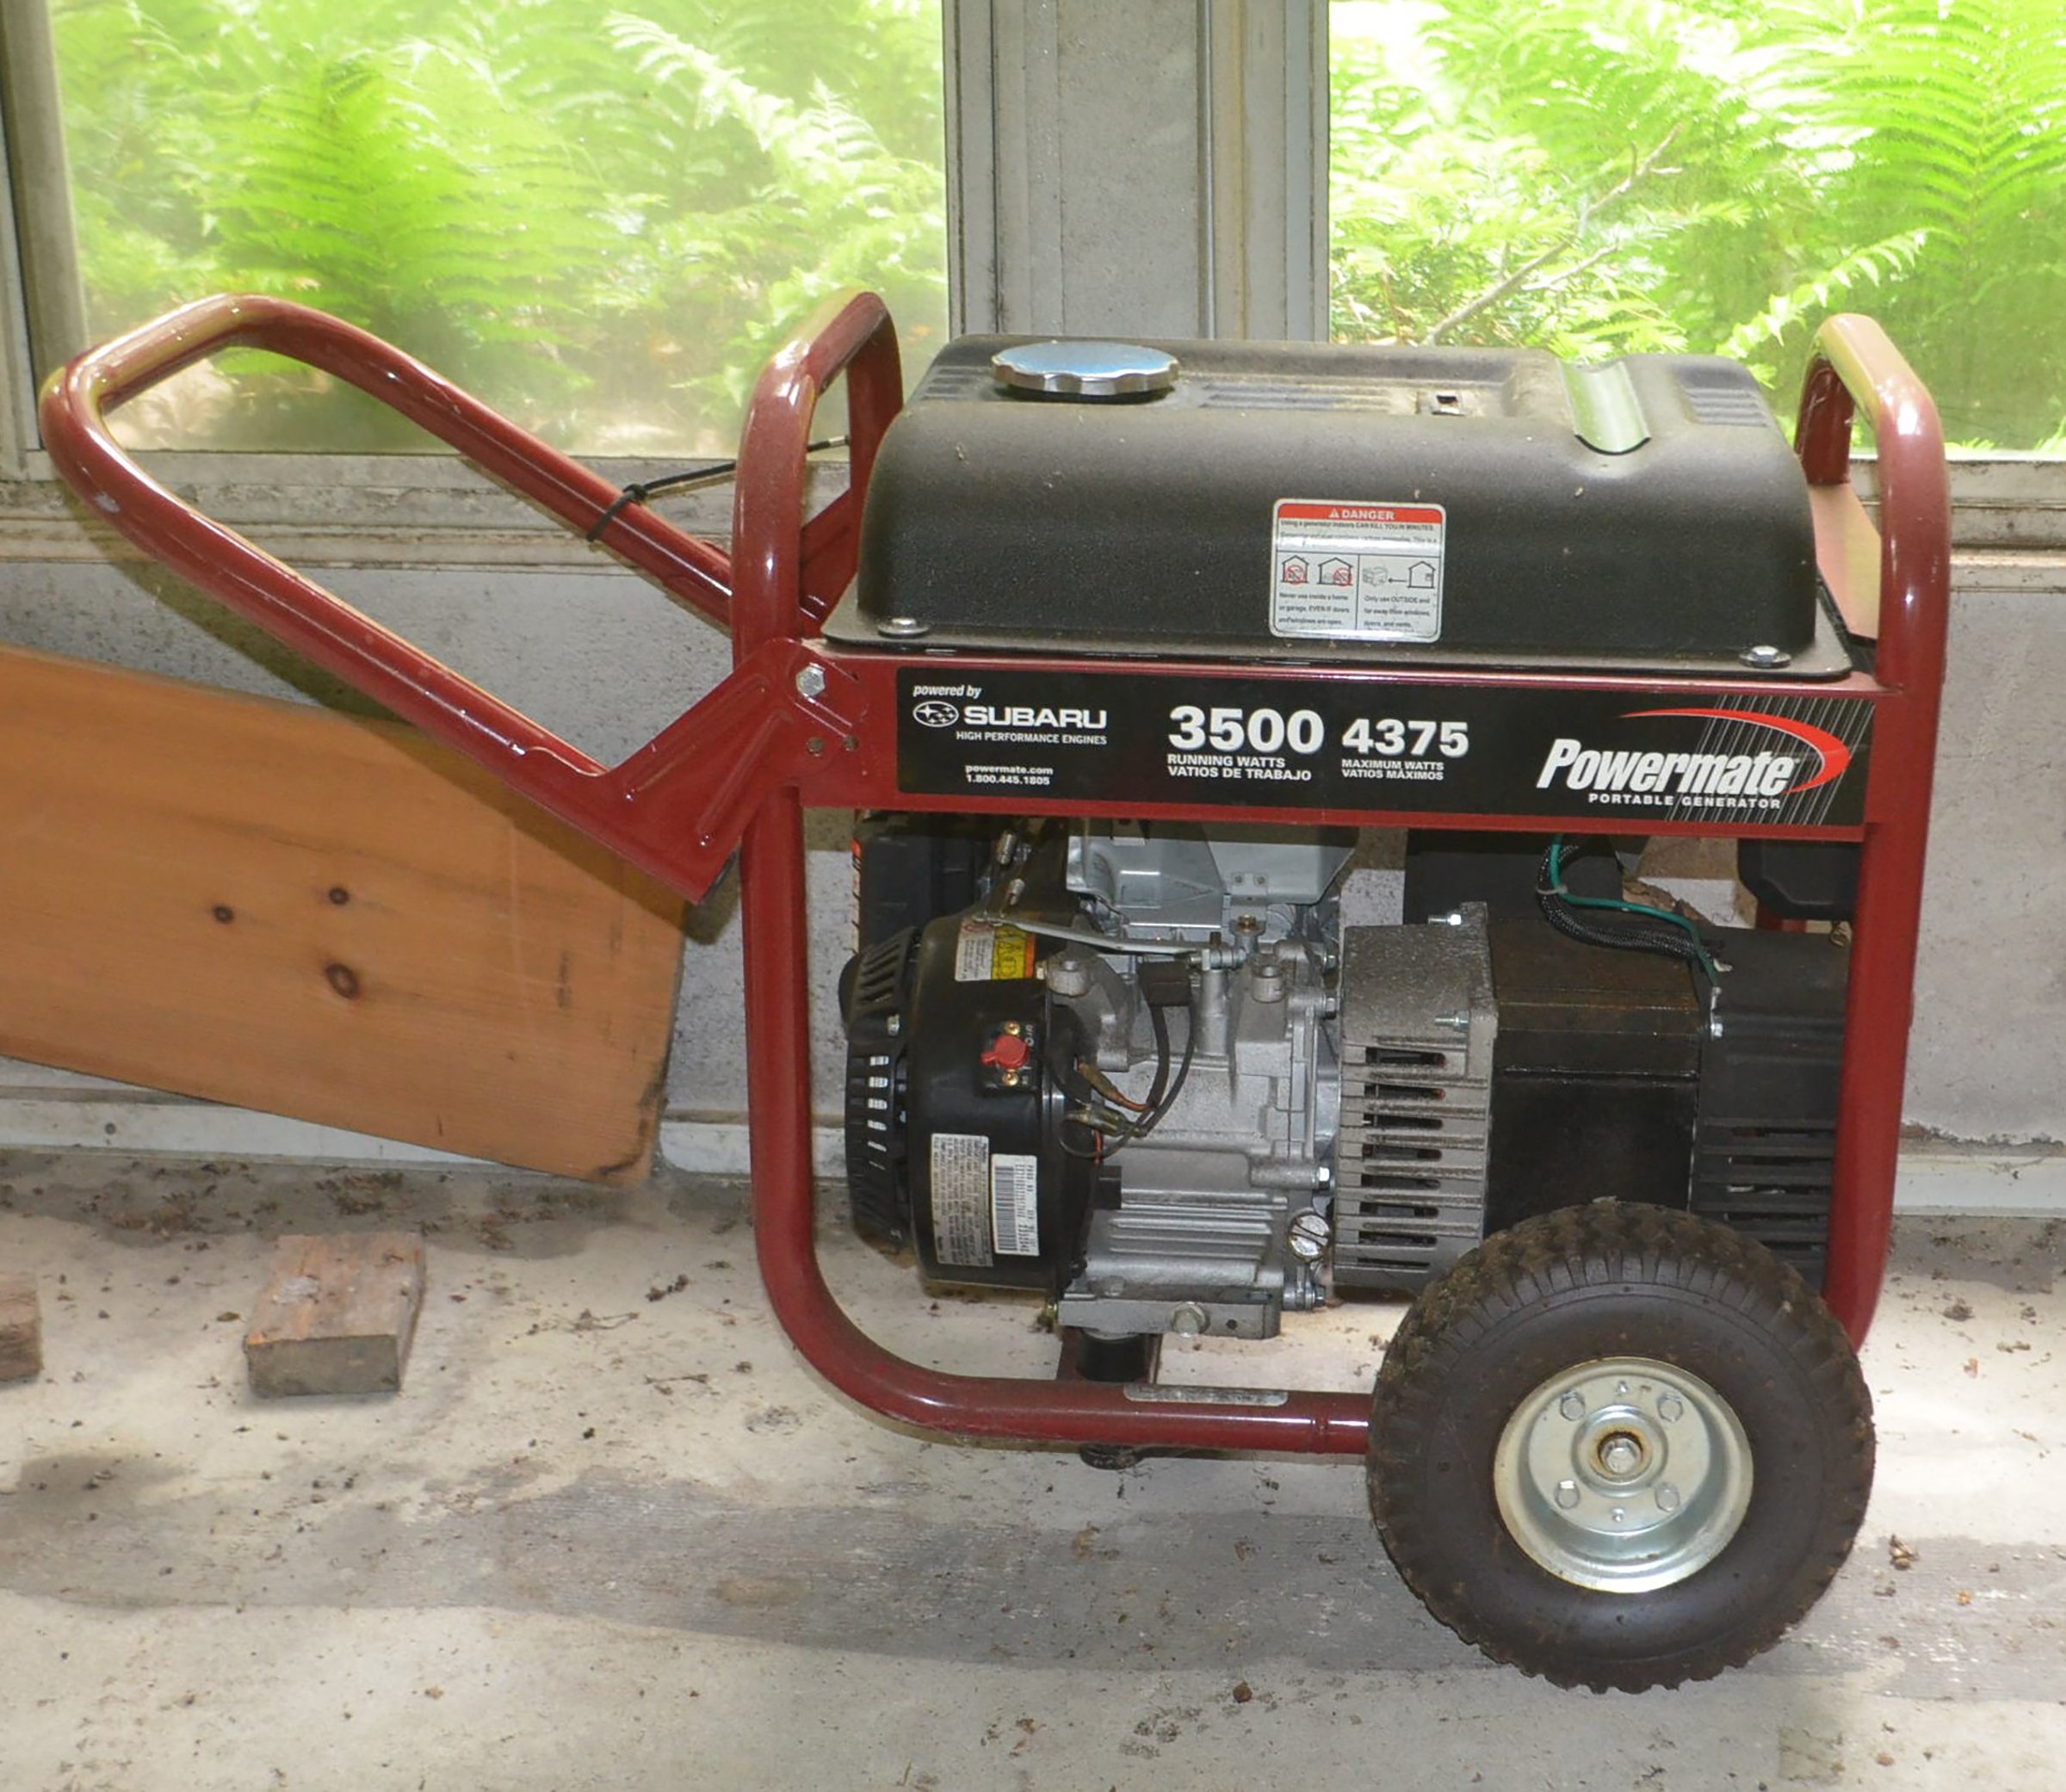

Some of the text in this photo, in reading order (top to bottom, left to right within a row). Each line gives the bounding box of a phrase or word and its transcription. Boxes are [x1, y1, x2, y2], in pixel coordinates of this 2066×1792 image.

[1342, 509, 1395, 520] DANGER
[912, 684, 982, 699] powered by
[964, 706, 1107, 729] SUBARU
[1168, 705, 1324, 754] 3500
[956, 731, 1108, 745] HIGH PERFORMANCE ENGINES
[1342, 719, 1469, 758] 4375
[1167, 754, 1285, 769] RUNNING WATTS
[1341, 758, 1444, 771] MAXIMUM WATTS
[1536, 738, 1795, 796] Powermate
[965, 764, 1054, 776] powermate.com
[1167, 765, 1312, 782] VATIOS DE TRABAJO
[1341, 768, 1444, 781] VATIOS MÁXIMOS
[966, 775, 1050, 785] 1.800.445.1805
[1588, 793, 1781, 809] PORTABLE GENERATOR
